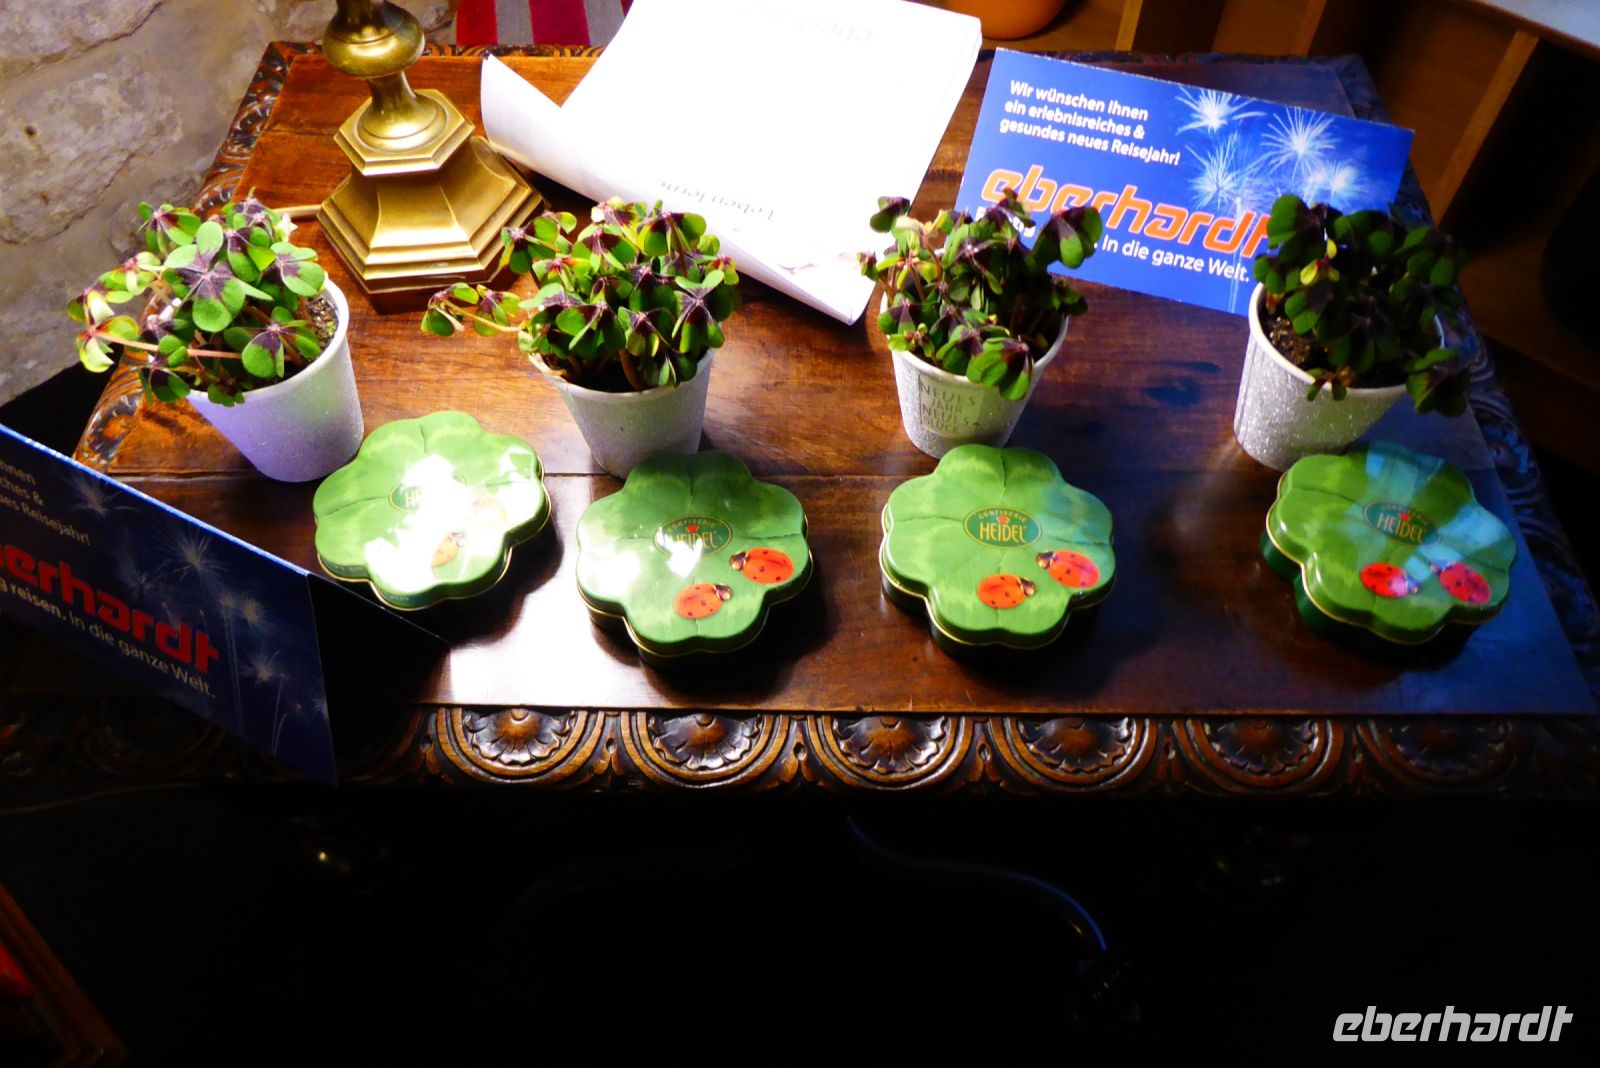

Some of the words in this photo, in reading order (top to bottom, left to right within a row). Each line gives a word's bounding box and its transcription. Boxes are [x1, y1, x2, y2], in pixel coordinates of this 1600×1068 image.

[1004, 99, 1026, 116] ein
[1028, 103, 1131, 137] erlebnisreiches
[1132, 124, 1145, 140] &
[1010, 79, 1034, 98] Wir
[1035, 88, 1105, 113] wünschen
[1107, 99, 1149, 121] Ihnen
[999, 118, 1065, 143] gesundes
[1067, 132, 1109, 152] neues
[1110, 138, 1181, 167] Reisejahr!
[981, 164, 1271, 259] eberhardt
[1101, 234, 1119, 253] In
[1121, 239, 1148, 260] die
[1151, 246, 1203, 272] ganze
[1208, 256, 1251, 284] Welt.
[917, 379, 976, 407] NEUES
[931, 398, 963, 414] JAHR
[20, 501, 92, 547] Reisejahr!
[979, 521, 1028, 544] HEIDEL
[0, 544, 220, 674] erhardt
[88, 622, 114, 646] die
[118, 639, 169, 675] ganze
[171, 661, 217, 699] Welt.
